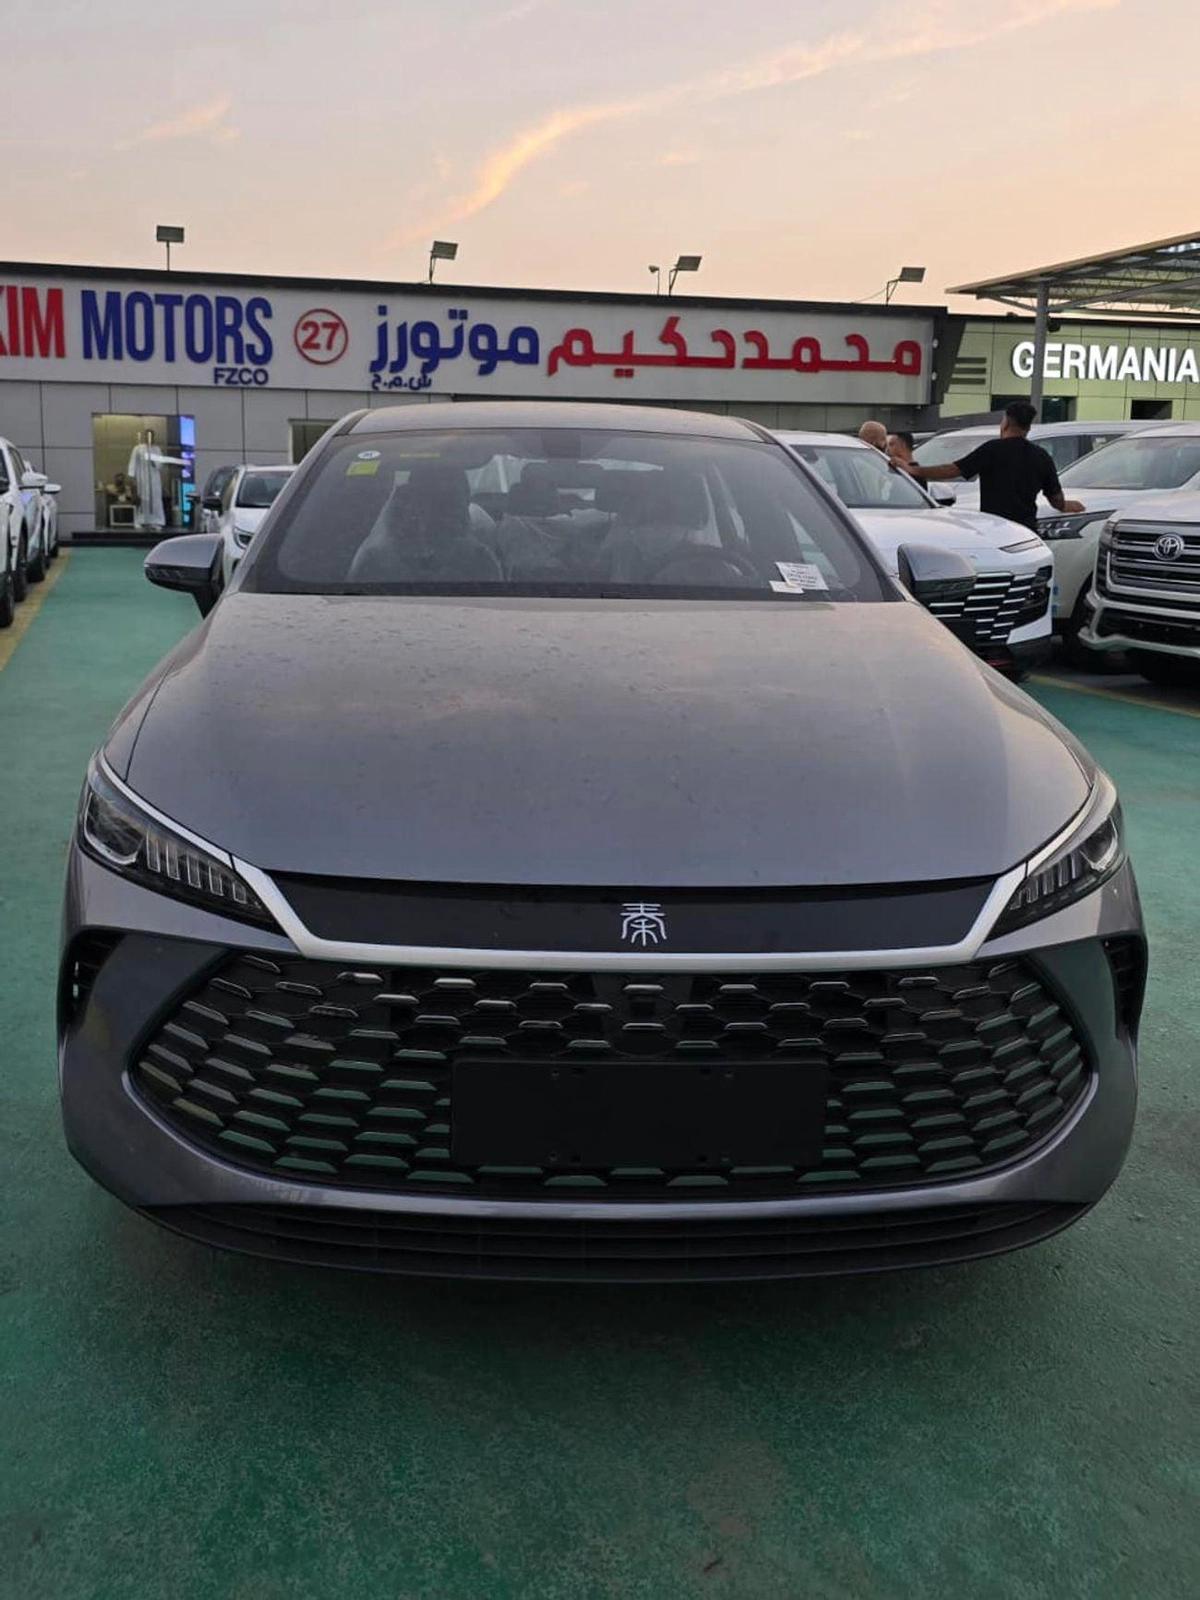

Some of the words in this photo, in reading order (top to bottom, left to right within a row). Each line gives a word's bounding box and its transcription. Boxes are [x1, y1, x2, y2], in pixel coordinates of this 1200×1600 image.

[80, 289, 273, 366] MOTORS
[301, 320, 340, 351] 27
[369, 304, 540, 376] موتورز
[546, 315, 737, 378] حكيم
[742, 328, 922, 376] محمد
[1012, 341, 1200, 383] GERMANIA
[213, 367, 270, 387] FZCO
